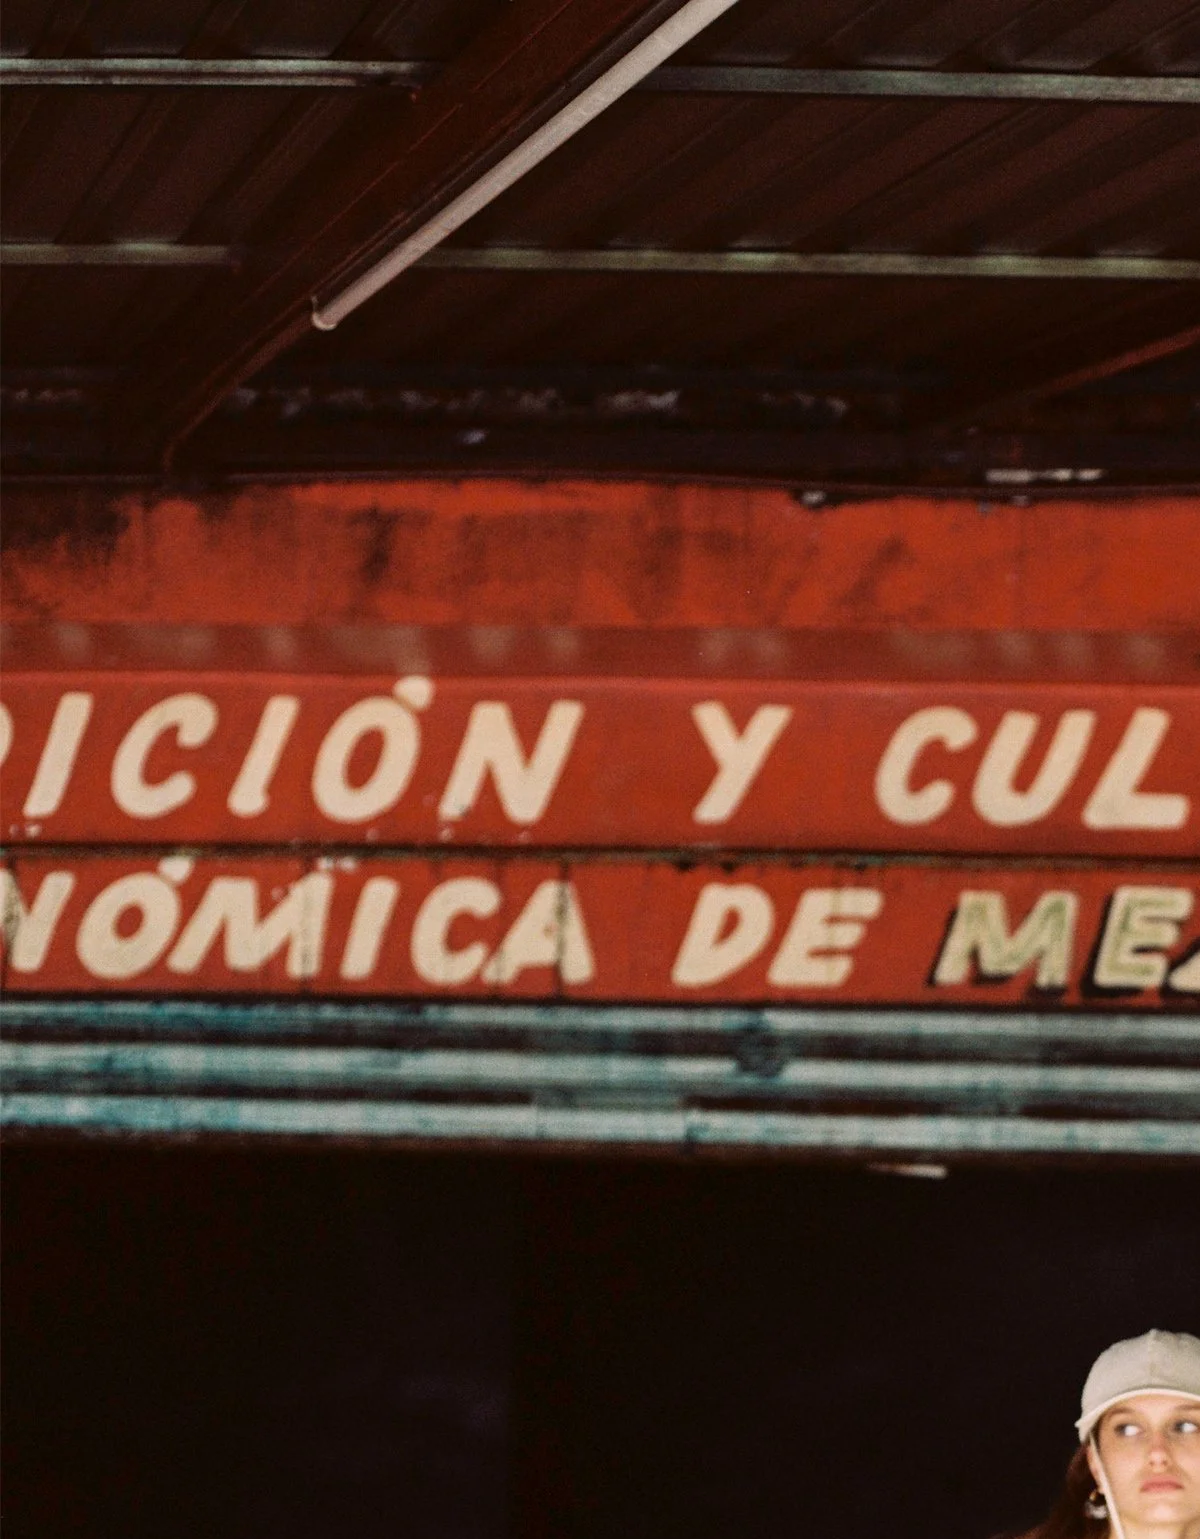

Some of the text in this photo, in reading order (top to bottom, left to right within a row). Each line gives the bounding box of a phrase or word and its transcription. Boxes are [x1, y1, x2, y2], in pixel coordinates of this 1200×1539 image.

[0, 675, 585, 824] ICIÓN
[691, 701, 793, 824] Y
[671, 883, 883, 987] DE
